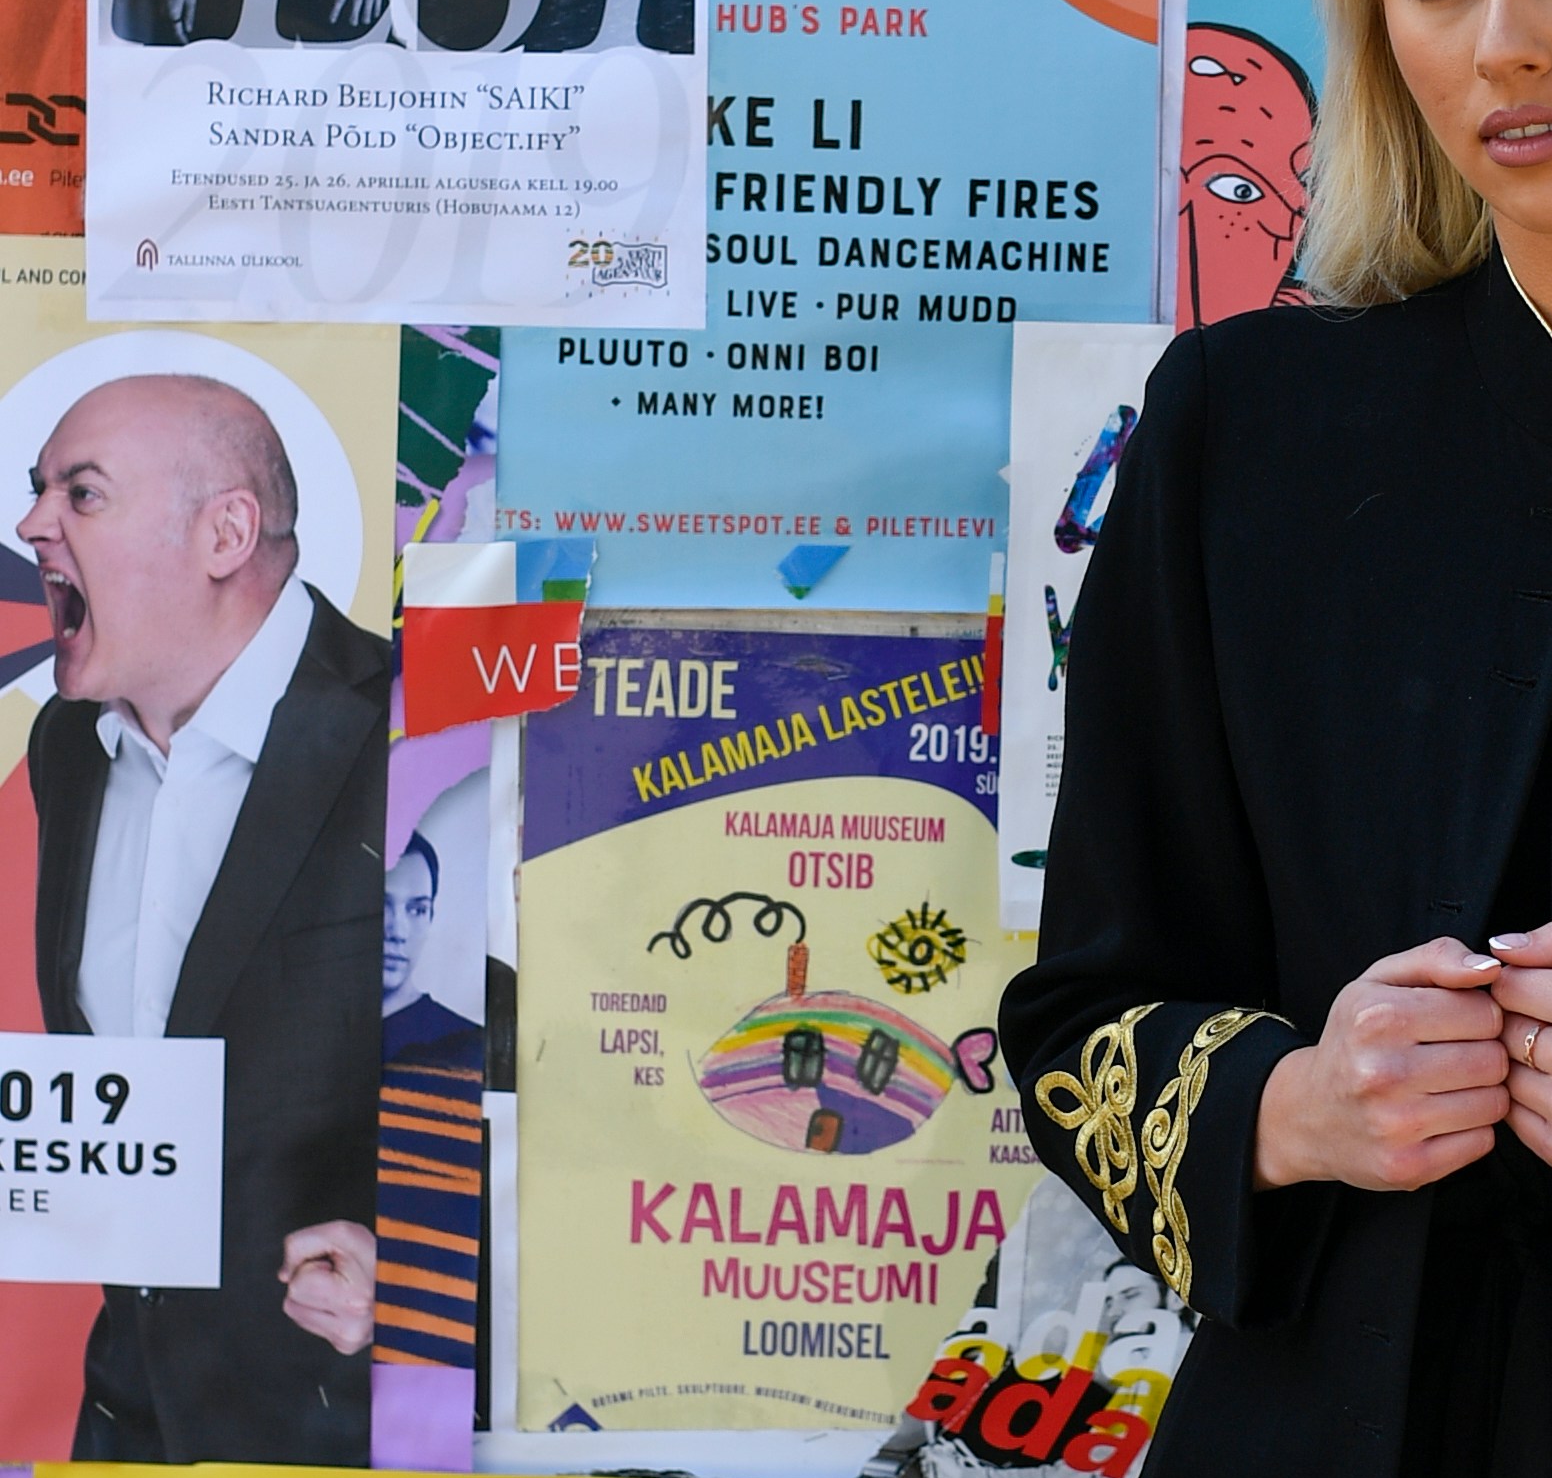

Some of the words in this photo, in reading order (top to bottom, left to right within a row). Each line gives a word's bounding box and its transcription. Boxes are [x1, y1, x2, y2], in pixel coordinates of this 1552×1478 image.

[839, 6, 929, 37] PARK
[206, 81, 328, 108] RICHARD
[338, 83, 468, 112] BELJOHIN
[207, 122, 314, 148] SANDRA
[325, 122, 397, 149] PÕLD
[812, 97, 863, 152] LI
[170, 169, 271, 189] ETENDUSED
[356, 176, 431, 191] APRILLIL
[435, 177, 522, 192] ALGUSEGA
[573, 178, 619, 195] 19.00
[714, 171, 943, 217] FRIENDLY
[967, 178, 1100, 221] FIRES
[208, 193, 256, 211] EESTI
[260, 195, 432, 215] TANTSUAGENTUURIS
[435, 198, 550, 219] (HOBUJAAMA
[554, 201, 581, 219] 12)
[167, 253, 236, 268] TALLINNA
[241, 251, 303, 268] ÜLIKOOL
[706, 232, 798, 267] SOUL
[817, 236, 1111, 273] DANCEMACHINE
[16, 268, 54, 285] AND
[727, 289, 798, 319] LIVE
[836, 292, 900, 322] PUR
[918, 293, 1018, 323] MUDD
[557, 337, 689, 368] PLUUTO
[727, 341, 806, 371] ONNI
[824, 343, 879, 372] BOI
[636, 391, 717, 418] MANY
[732, 393, 824, 420] MORE!
[555, 511, 823, 536] WWW.SWEETSPOT.EE
[834, 516, 851, 535] &
[866, 516, 996, 538] PILETILEVI
[587, 657, 739, 720] TEADE
[631, 710, 818, 803] KALAMAJA
[724, 811, 836, 840] KALAMAJA
[841, 814, 946, 843] MUUSEUM
[788, 851, 874, 890] OTSIB
[589, 992, 667, 1015] TOREDAID
[599, 1029, 665, 1058] LAPSI,
[633, 1066, 665, 1087] KES
[0, 1138, 178, 1176] ESKUS
[629, 1179, 1007, 1255] KALAMAJA
[702, 1257, 939, 1307] MUUSEUMI
[742, 1319, 891, 1360] LOOMISEL
